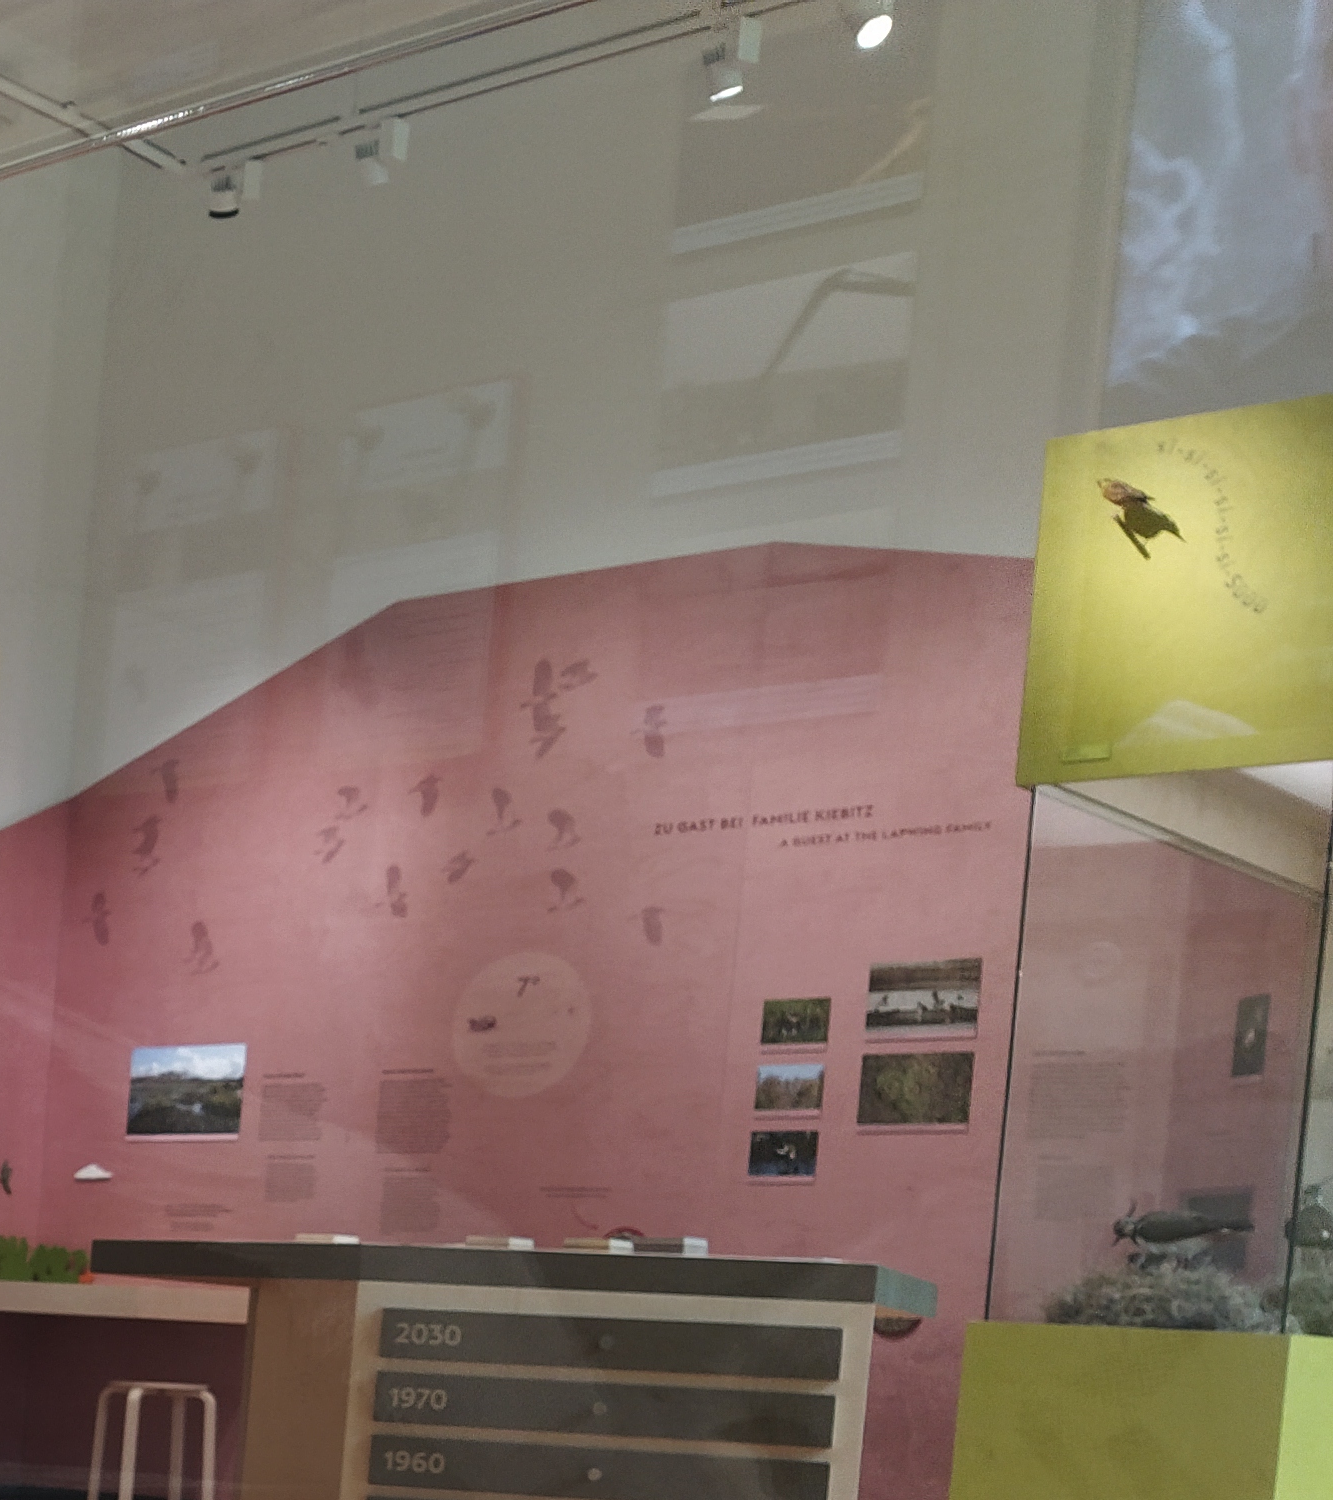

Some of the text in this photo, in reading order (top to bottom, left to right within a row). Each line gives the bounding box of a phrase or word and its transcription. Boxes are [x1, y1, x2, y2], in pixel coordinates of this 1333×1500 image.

[393, 1322, 462, 1347] 2030
[390, 1386, 448, 1411] 1970
[384, 1450, 446, 1475] 1960
